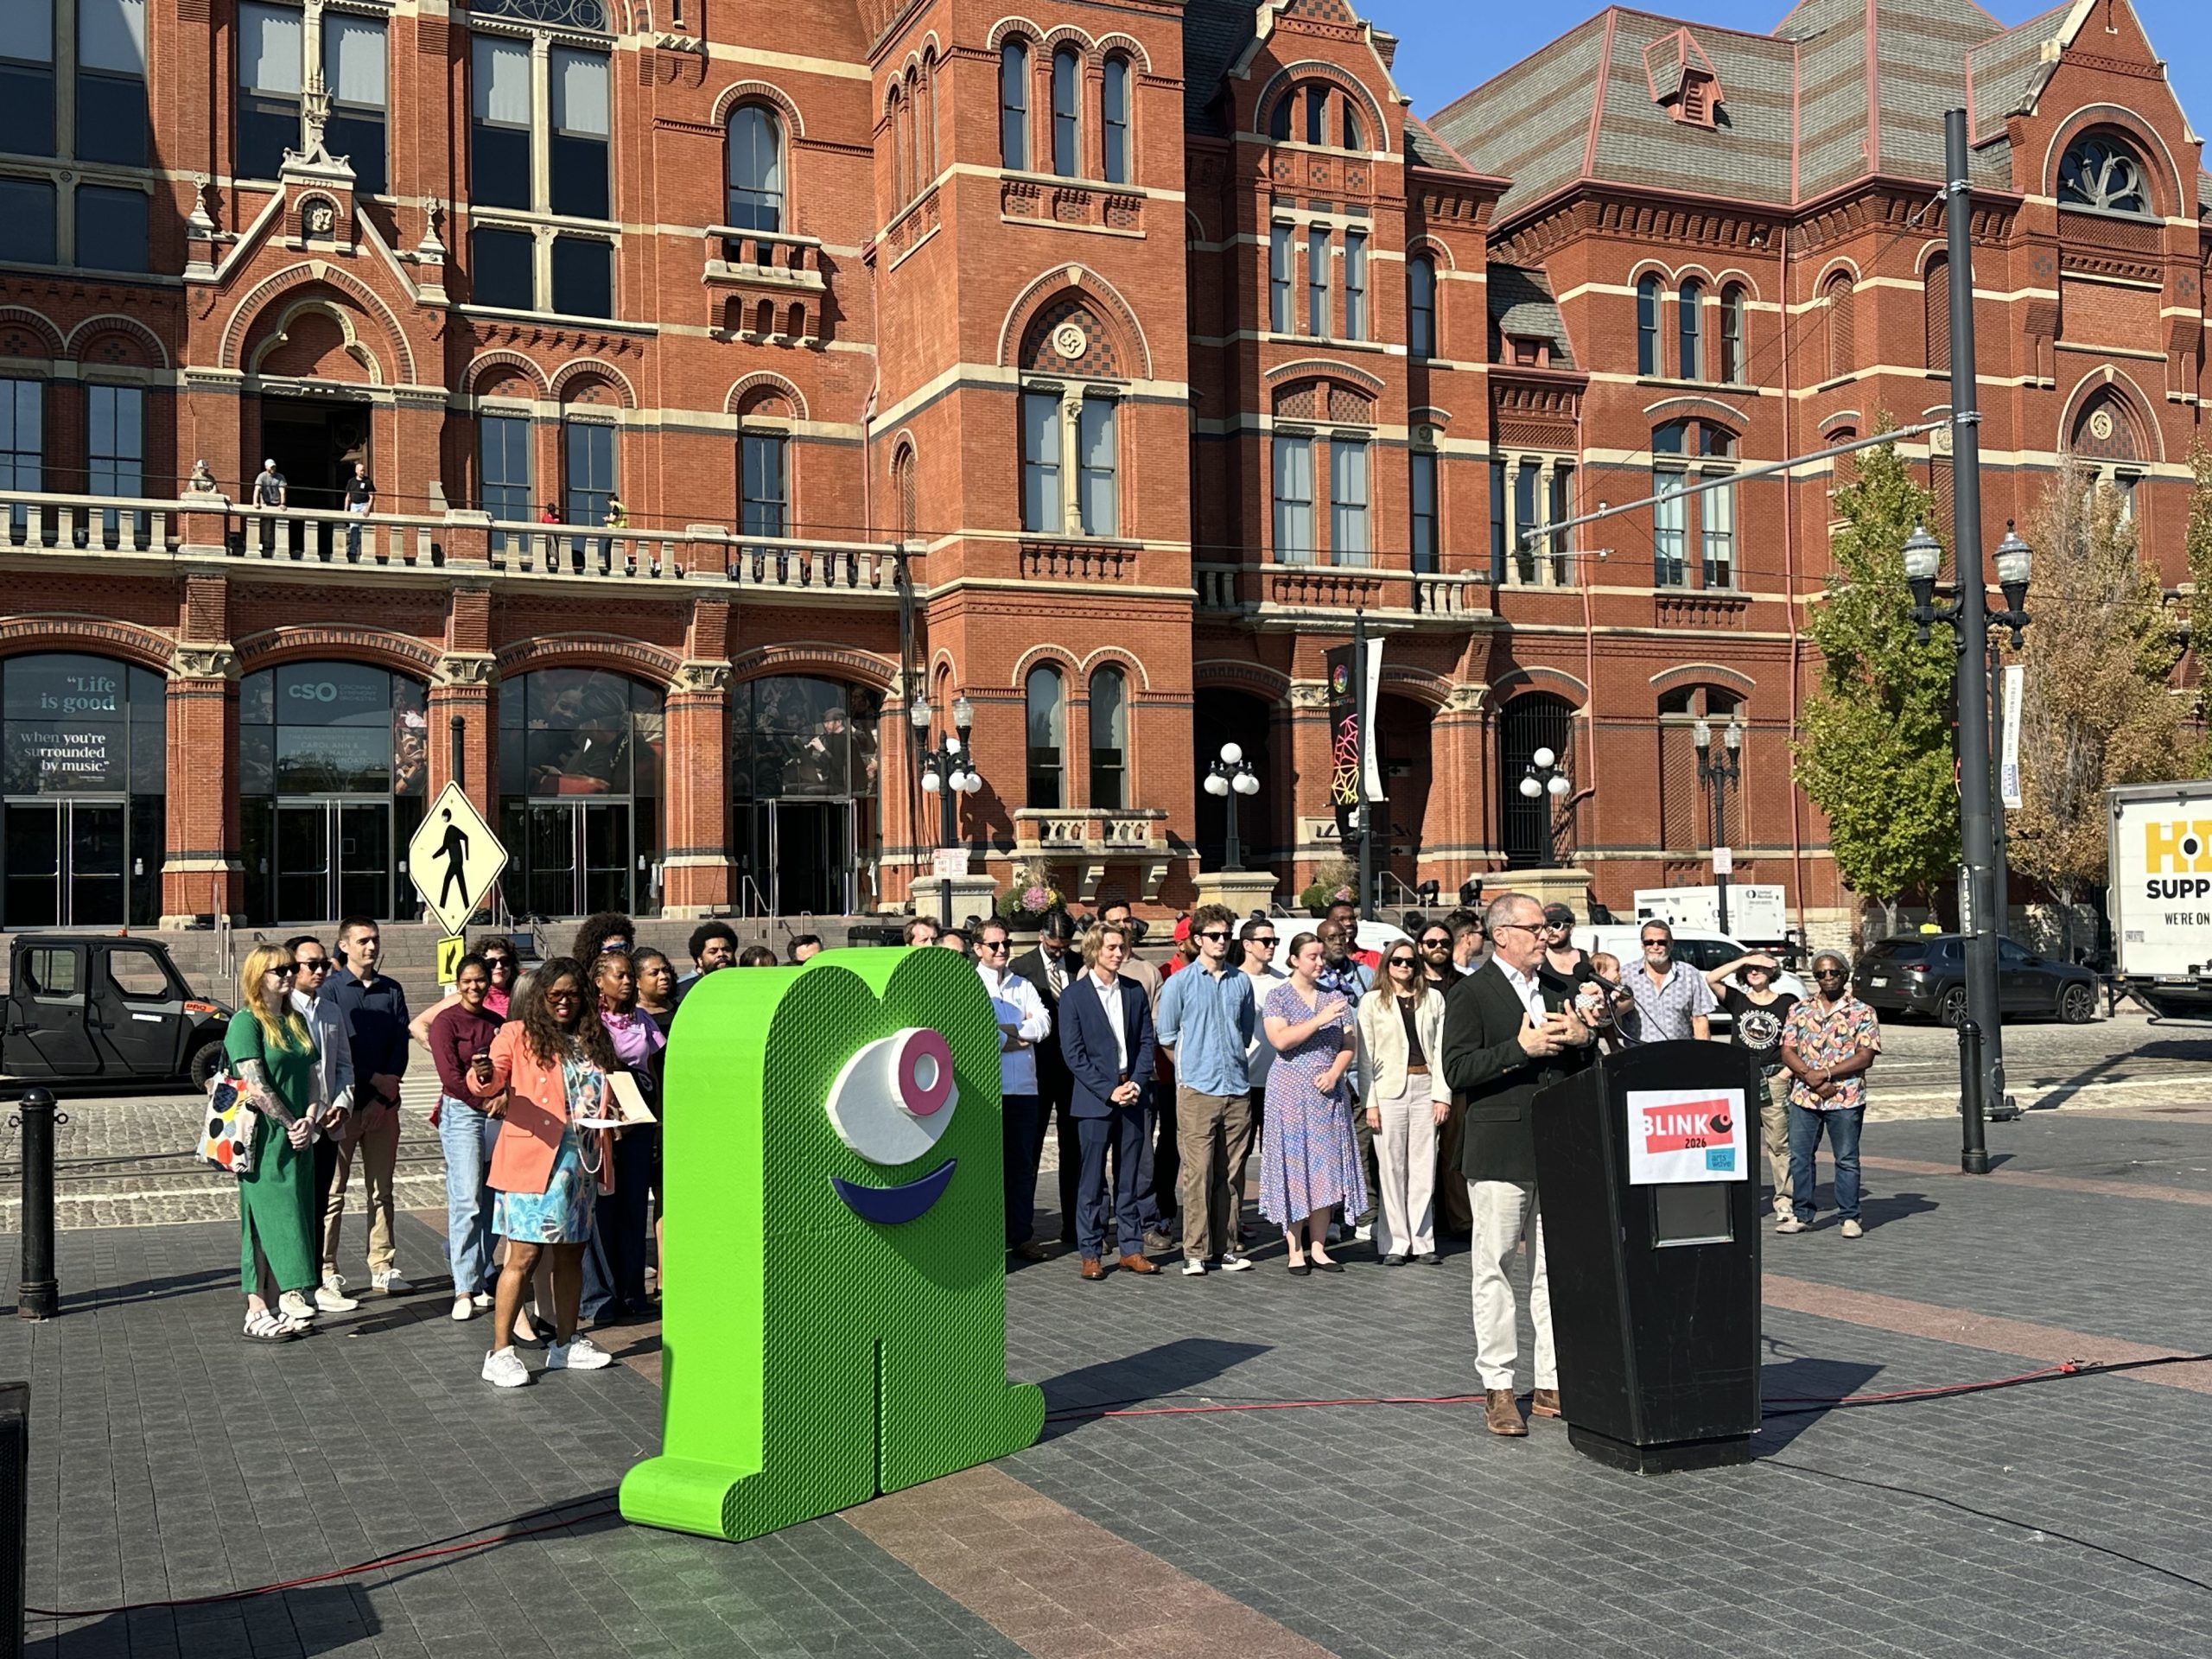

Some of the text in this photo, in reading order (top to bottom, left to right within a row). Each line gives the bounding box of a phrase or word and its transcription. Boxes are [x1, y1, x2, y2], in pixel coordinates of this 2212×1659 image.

[41, 693, 116, 713] is good
[21, 732, 60, 743] when
[24, 747, 105, 758] surrounded
[41, 760, 59, 774] by
[2196, 912, 2210, 925] ON
[1643, 1113, 1710, 1136] BLINK
[1685, 1137, 1707, 1149] 2026
